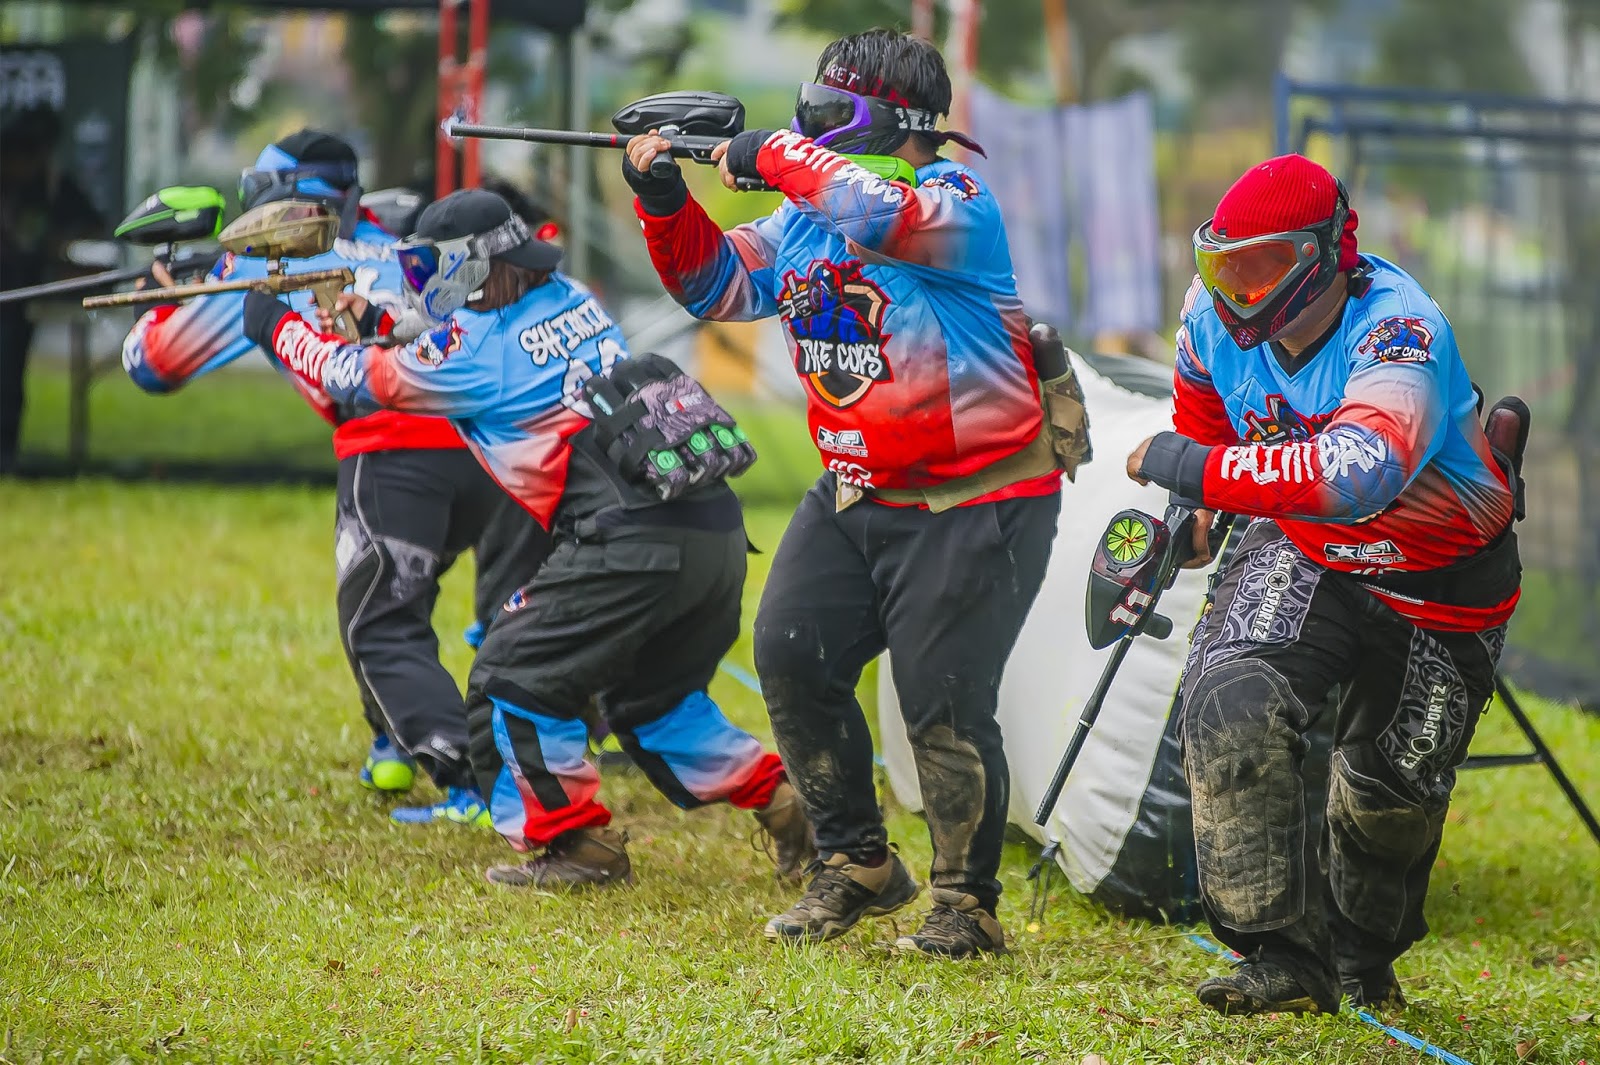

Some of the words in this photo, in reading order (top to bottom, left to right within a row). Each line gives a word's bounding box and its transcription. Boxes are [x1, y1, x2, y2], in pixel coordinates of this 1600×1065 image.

[797, 339, 833, 377] THE
[836, 343, 883, 378] COPS
[1250, 588, 1283, 641] SPORTZ
[1422, 684, 1447, 740] SPORTZ
